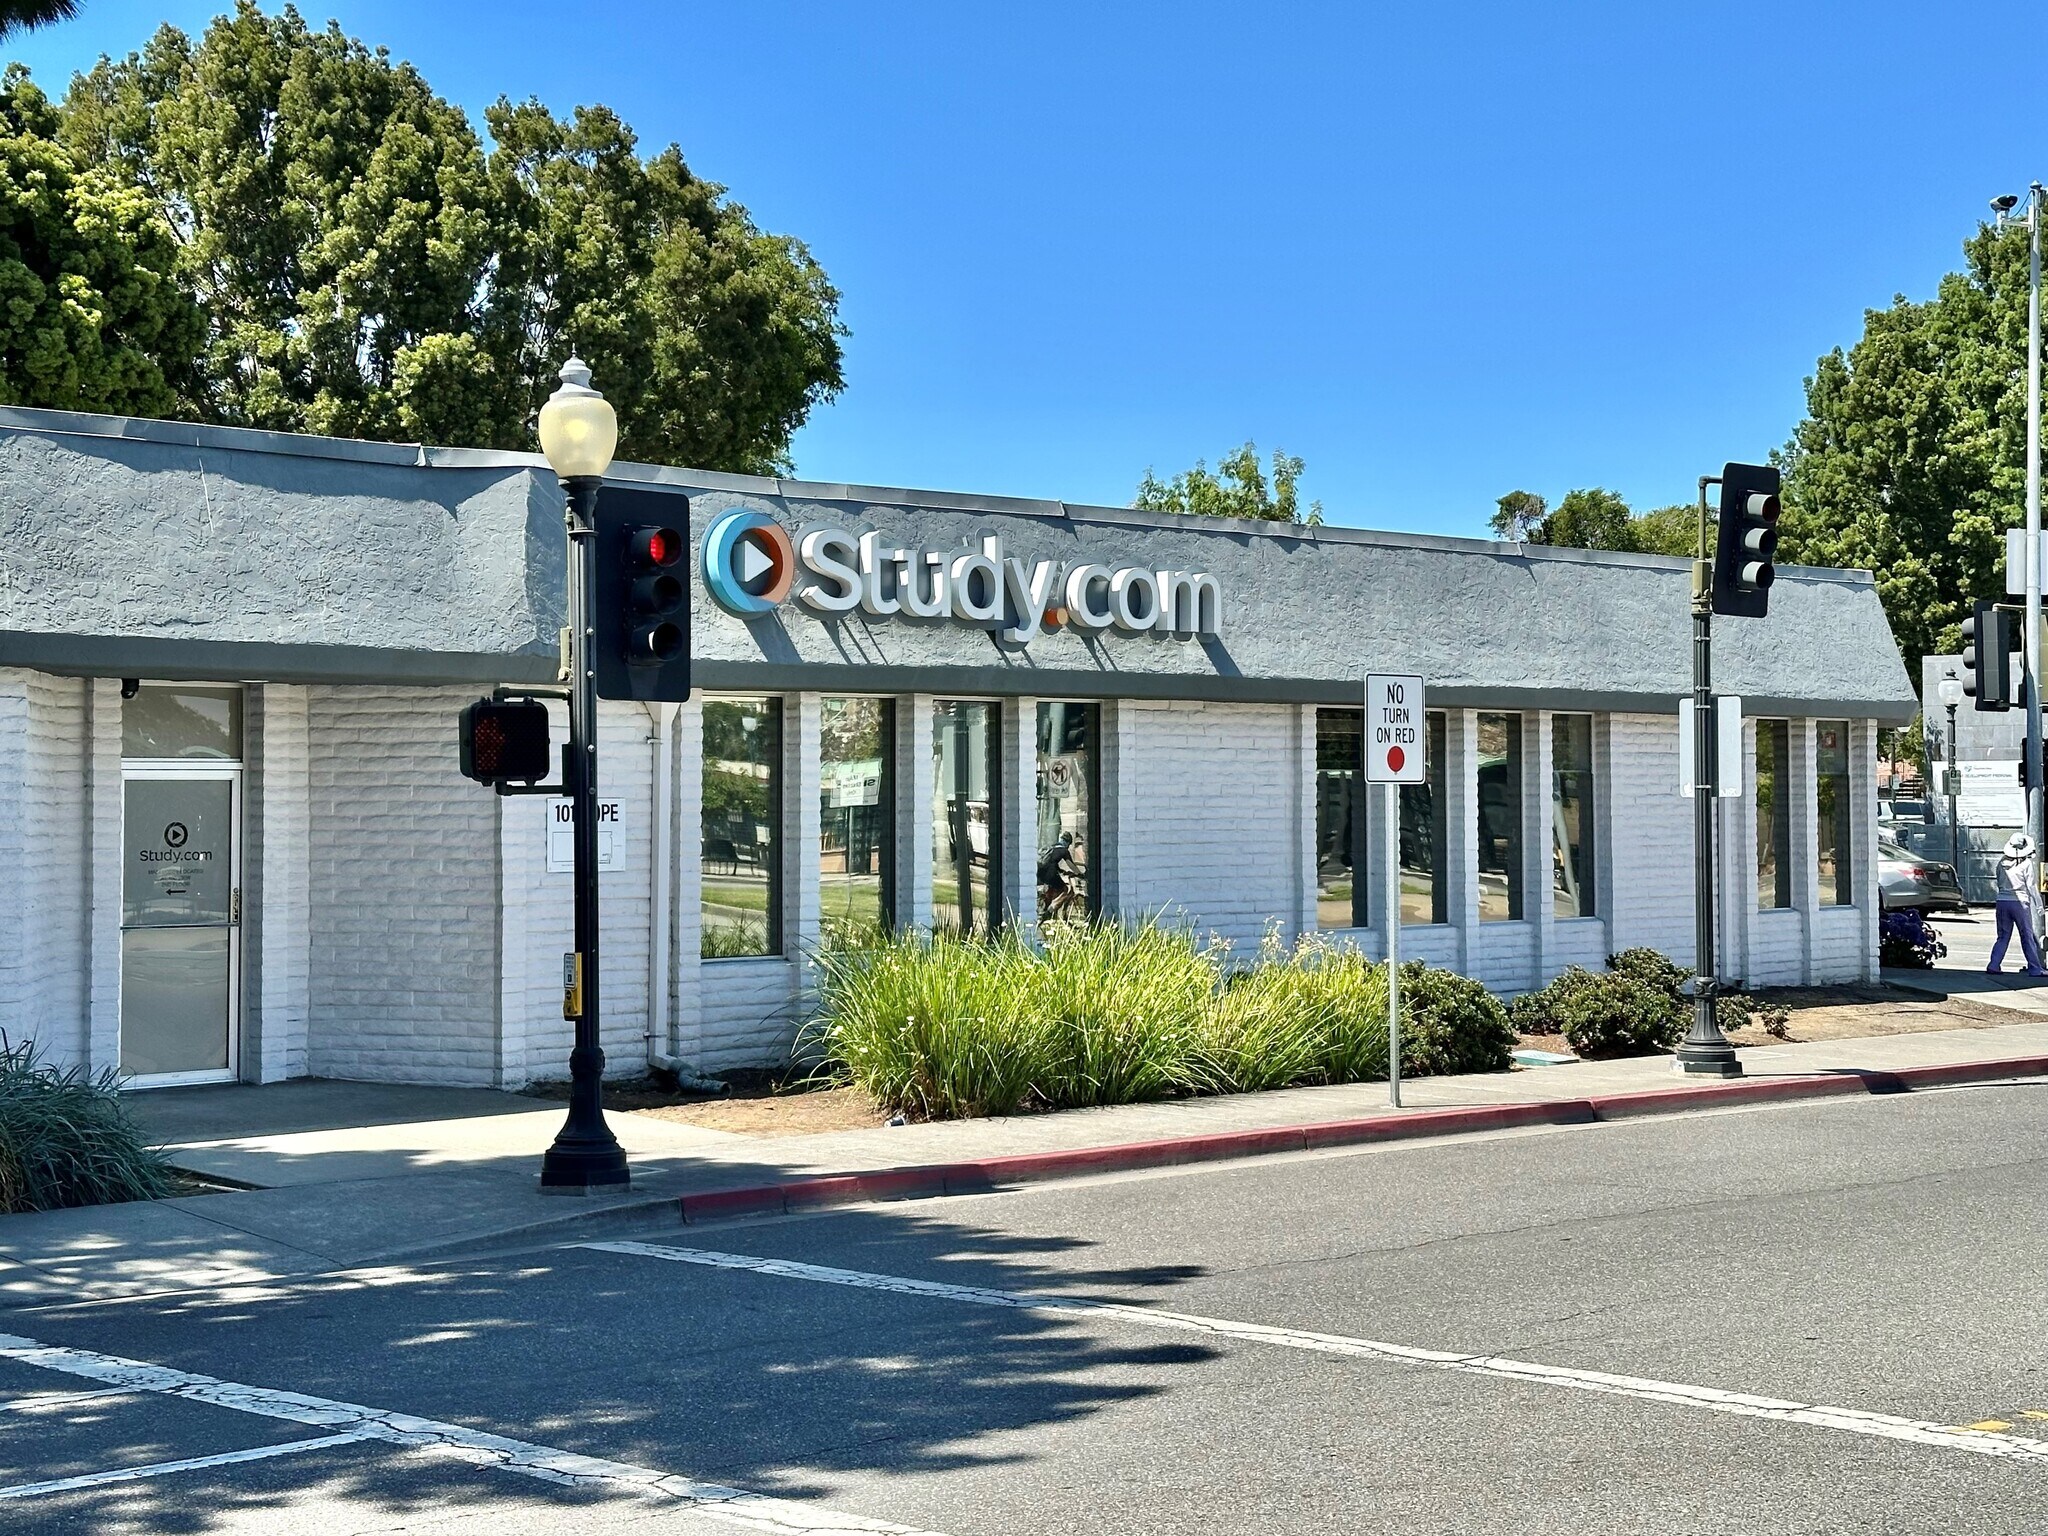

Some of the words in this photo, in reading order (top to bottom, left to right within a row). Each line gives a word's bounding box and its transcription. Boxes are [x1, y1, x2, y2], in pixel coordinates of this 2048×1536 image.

[799, 528, 1223, 646] Study.com
[1387, 684, 1404, 704] NO
[1383, 708, 1409, 724] TURN
[1376, 727, 1391, 743] ON
[1395, 727, 1415, 744] RED
[597, 803, 618, 822] PE
[139, 849, 213, 864] Study.com
